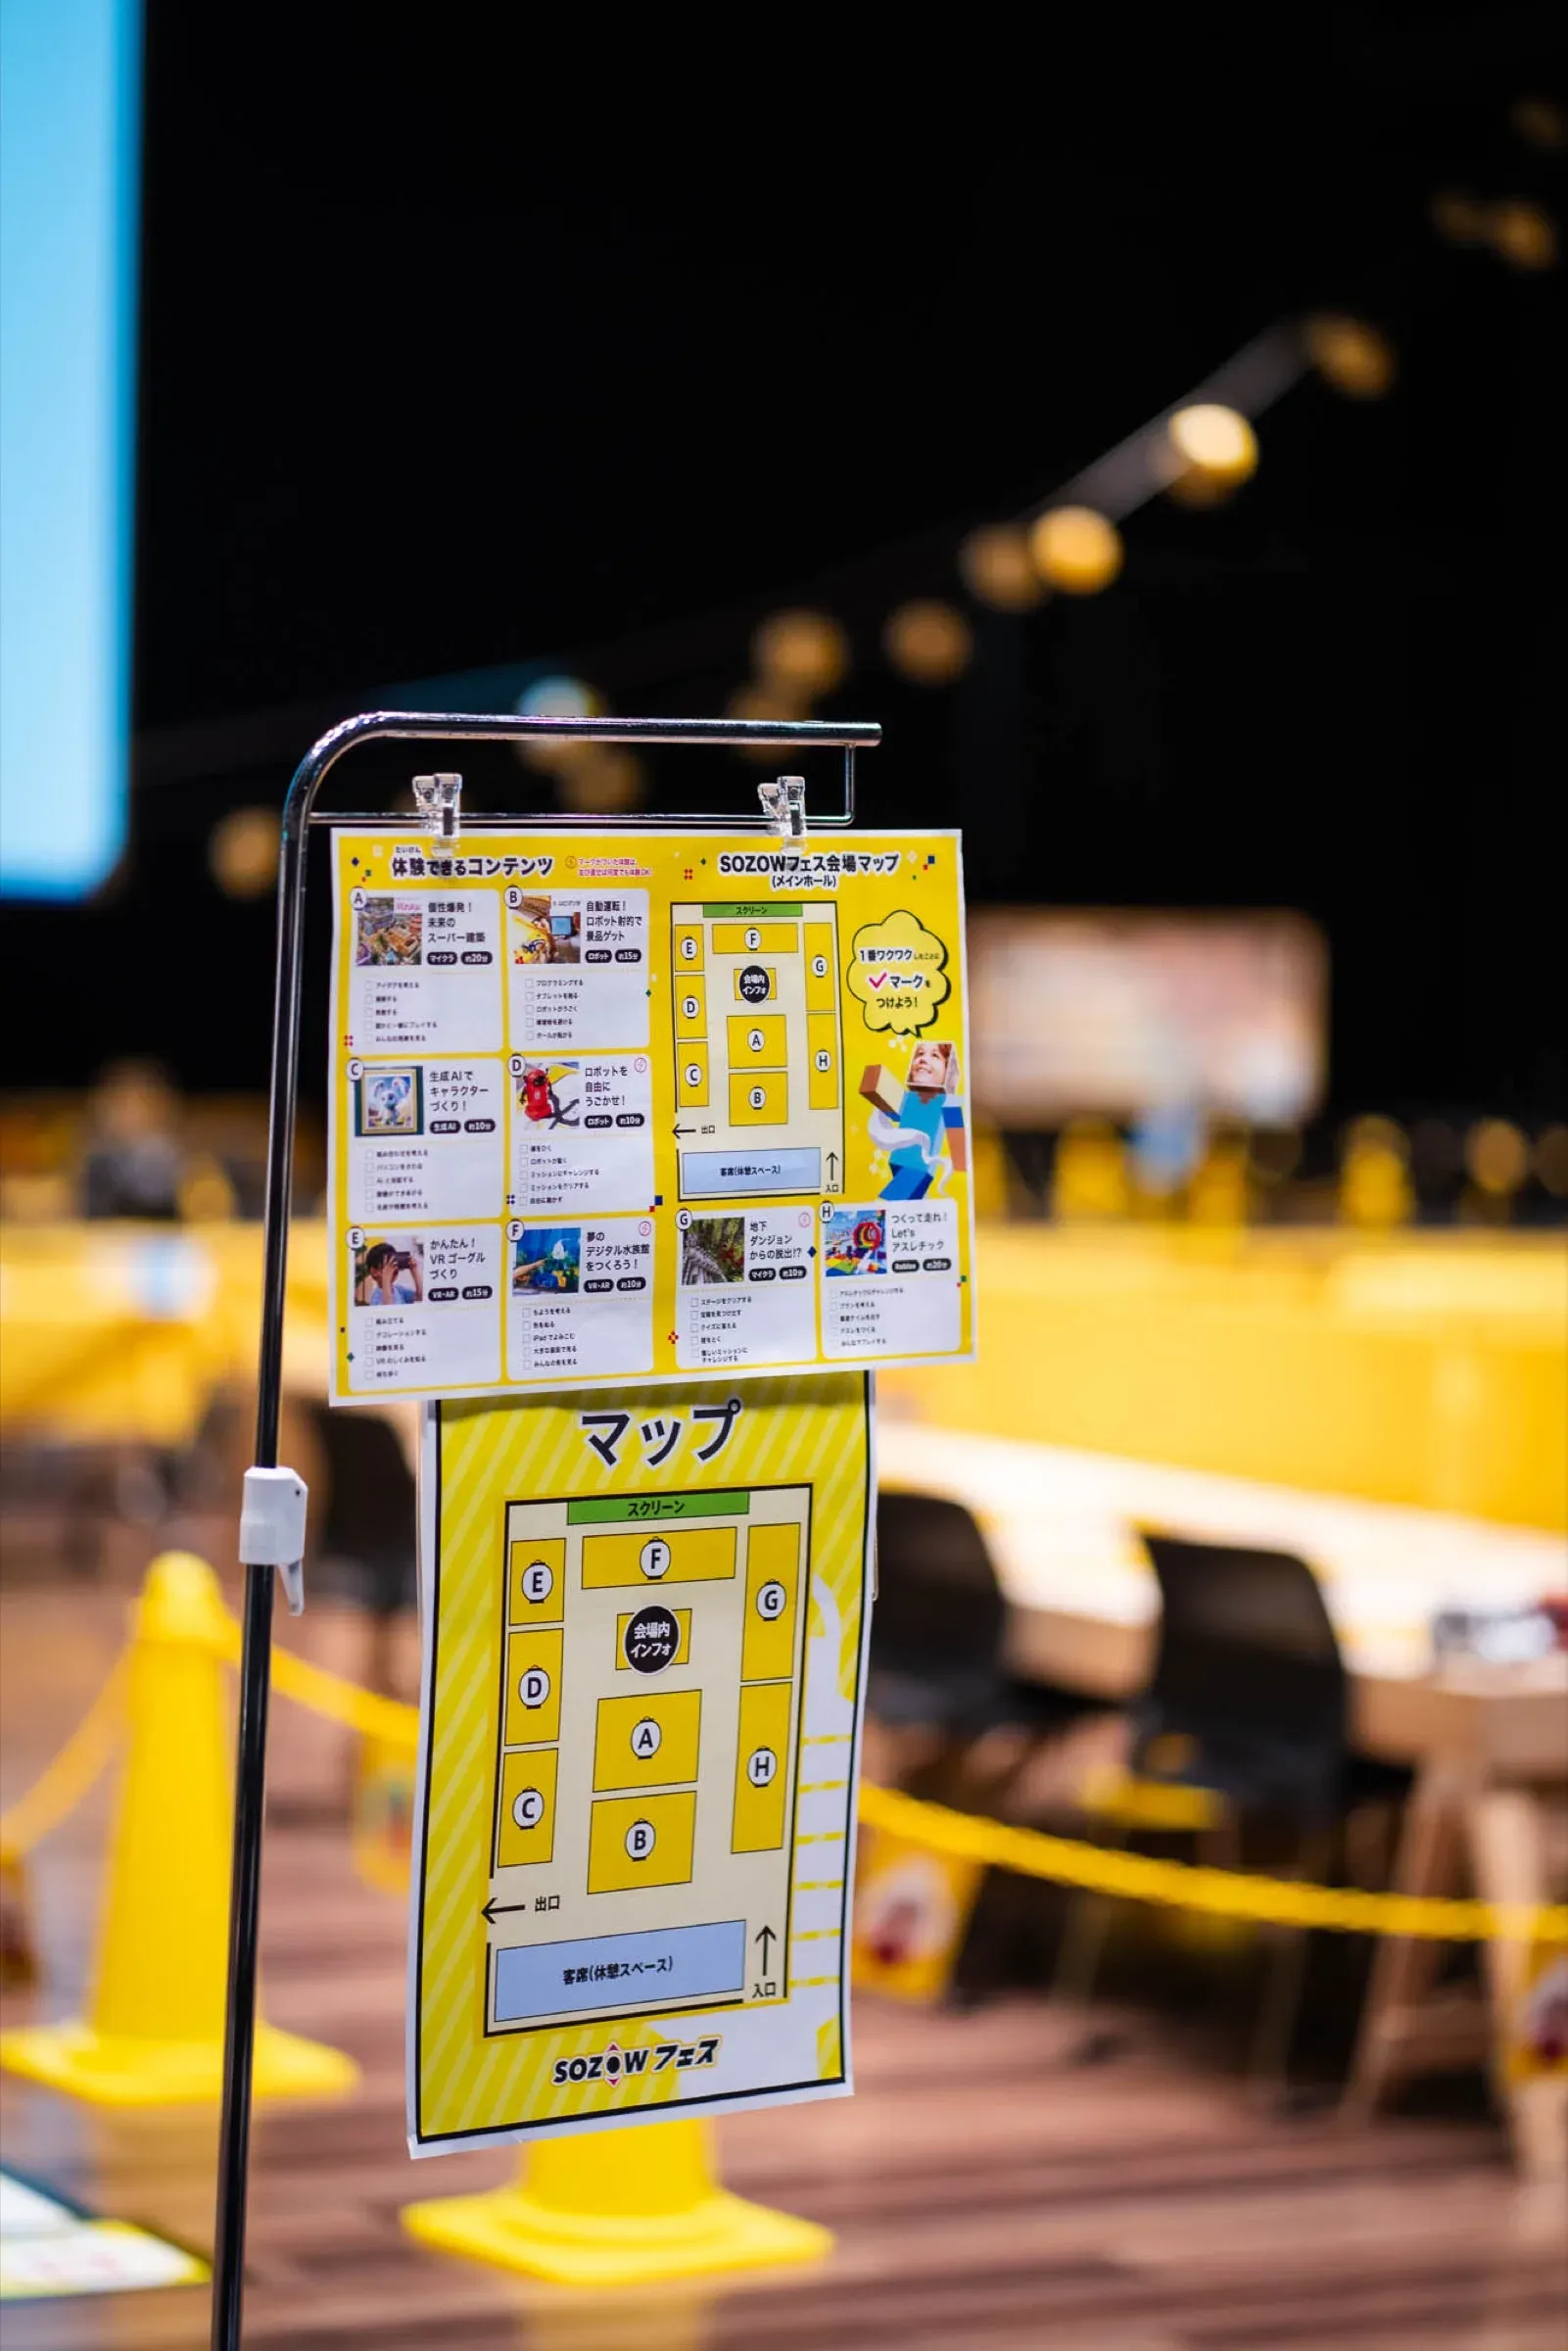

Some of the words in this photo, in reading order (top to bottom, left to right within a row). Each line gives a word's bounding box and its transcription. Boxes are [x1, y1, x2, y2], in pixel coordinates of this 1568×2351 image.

[392, 857, 552, 876] 体験できるコンテンツ
[720, 854, 899, 873] SOZOWフェス会場マップ
[772, 875, 836, 888] (メインホール)
[354, 891, 363, 903] A
[509, 890, 518, 903] B
[736, 906, 768, 915] スクリーン
[427, 917, 456, 928] 未来の
[586, 916, 642, 927] ロボット射的で
[427, 933, 486, 942] スーパー建築
[586, 931, 625, 941] 景品ゲット
[750, 933, 757, 945] F
[686, 942, 693, 954] E
[464, 953, 489, 962] 約20分
[618, 951, 639, 960] 約15分
[815, 960, 825, 972] G
[743, 975, 765, 984] 会場内
[742, 985, 766, 995] インフォ
[687, 1001, 695, 1013] D
[751, 1034, 762, 1046] A
[512, 1060, 521, 1072] D
[819, 1056, 828, 1068] H
[351, 1062, 359, 1076] C
[585, 1066, 628, 1078] ロボットを
[689, 1069, 697, 1081] C
[430, 1085, 489, 1097] キャラクター
[586, 1081, 610, 1093] 自由に
[754, 1092, 762, 1104] B
[701, 1125, 715, 1134] 出口
[826, 1184, 838, 1193] 入口
[822, 1206, 831, 1218] H
[680, 1214, 689, 1225] G
[511, 1224, 519, 1236] F
[750, 1221, 768, 1232] 地下
[351, 1232, 359, 1244] E
[587, 1232, 605, 1242] 夢の
[750, 1234, 792, 1246] ダンジョン
[586, 1244, 650, 1258] デジタル水族館
[892, 1240, 944, 1252] アスレチック
[429, 1270, 457, 1279] づくり
[751, 1271, 774, 1279] マイクラ
[466, 1288, 488, 1297] 約15分
[582, 1399, 741, 1465] マップ
[627, 1501, 686, 1516] スクリーン
[650, 1548, 662, 1569] F
[532, 1571, 544, 1593] E
[764, 1590, 778, 1610] G
[634, 1620, 670, 1640] 会場内
[630, 1642, 672, 1657] インフォ
[527, 1676, 542, 1699] D
[639, 1728, 654, 1750] A
[754, 1756, 770, 1777] H
[521, 1798, 536, 1820] C
[634, 1830, 646, 1850] B
[535, 1895, 560, 1912] 出口
[562, 1955, 674, 1986] 客席(休憩スペース)
[752, 1981, 777, 1998] 入口
